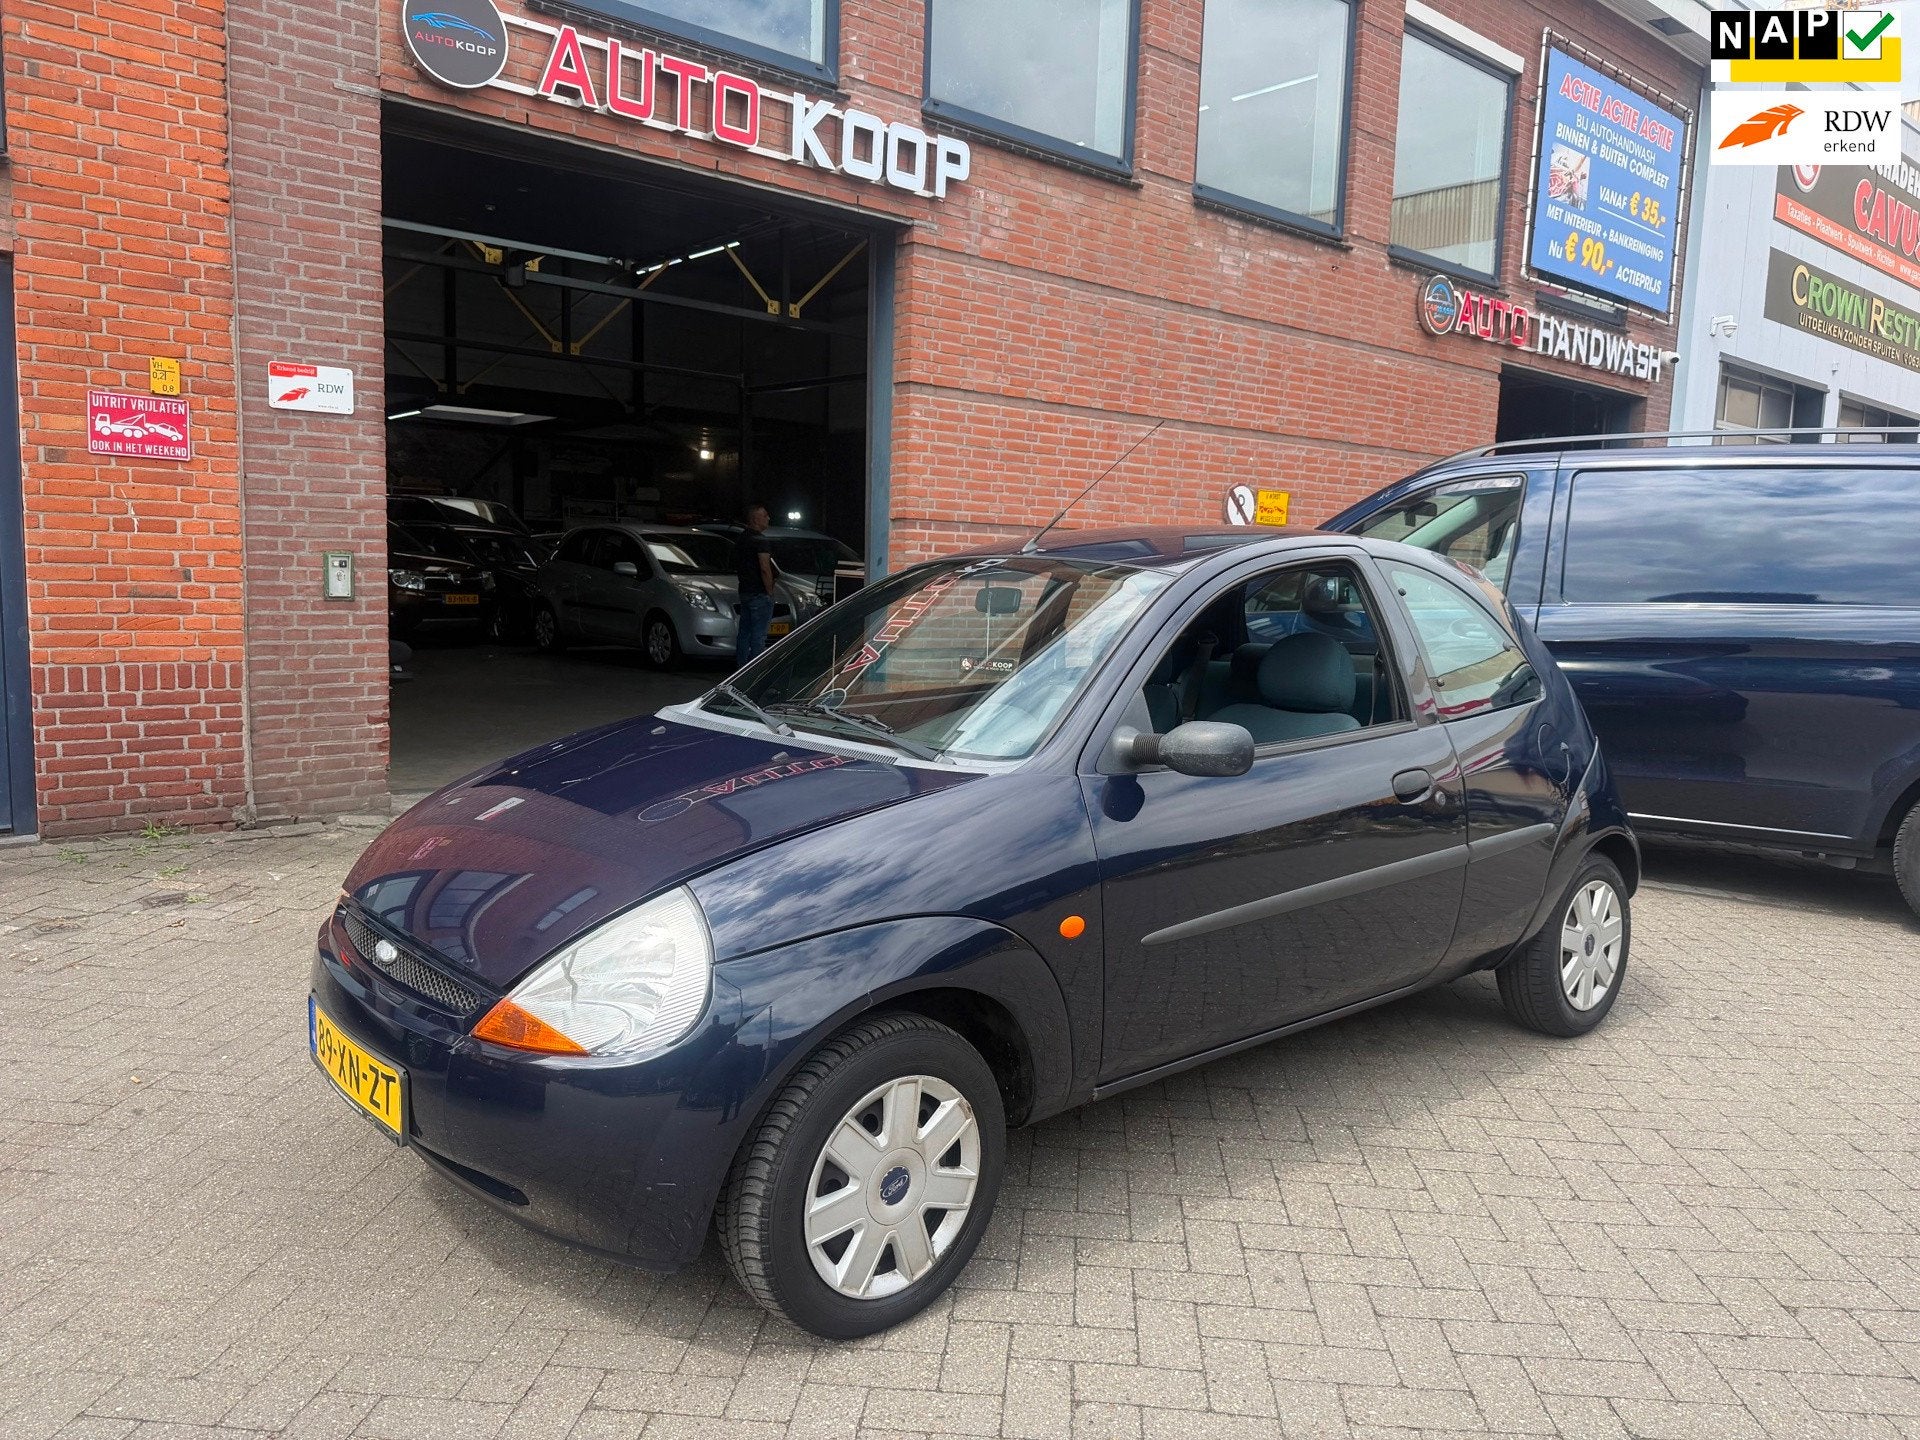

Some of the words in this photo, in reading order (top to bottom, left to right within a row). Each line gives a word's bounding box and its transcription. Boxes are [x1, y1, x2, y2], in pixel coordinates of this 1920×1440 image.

[415, 31, 497, 56] AUTOKOOP
[538, 24, 761, 150] AUTO
[791, 92, 972, 200] KOOP
[1559, 73, 1602, 113] ACTIE
[1600, 95, 1640, 133] ACTIE
[1638, 115, 1675, 152] ACTIE
[1556, 122, 1590, 151] BINNEN
[1592, 139, 1598, 154] &
[1600, 144, 1628, 169] BUITEN
[1629, 159, 1670, 189] COMPLEET
[1576, 114, 1588, 131] BIJ
[1590, 121, 1656, 165] AUTOHANDWASH
[1600, 185, 1628, 210] VANAF
[1629, 191, 1641, 216] €
[1546, 204, 1563, 222] MET
[1564, 210, 1602, 239] INTERIEUR
[1602, 230, 1608, 239] +
[1609, 228, 1664, 262] BANKREINIGING
[1564, 231, 1579, 262] €
[1615, 265, 1662, 295] ACTIEPRIJS
[1792, 264, 1868, 330] CROWN
[1455, 290, 1529, 346] AUTO
[1537, 312, 1662, 383] HANDWASH
[1800, 313, 1843, 339] UITDEUKEN
[1843, 329, 1872, 350] ZONDER
[1873, 340, 1900, 361] SPUITEN
[152, 361, 162, 369] VH
[317, 383, 344, 394] RDW
[92, 395, 127, 409] UITRIT
[130, 398, 185, 415] VRIJLATEN
[92, 440, 111, 450] OOK
[113, 441, 122, 451] IN
[125, 443, 142, 453] HET
[144, 444, 187, 457] WEEKEND
[318, 1018, 396, 1116] 89-XN-ZT
